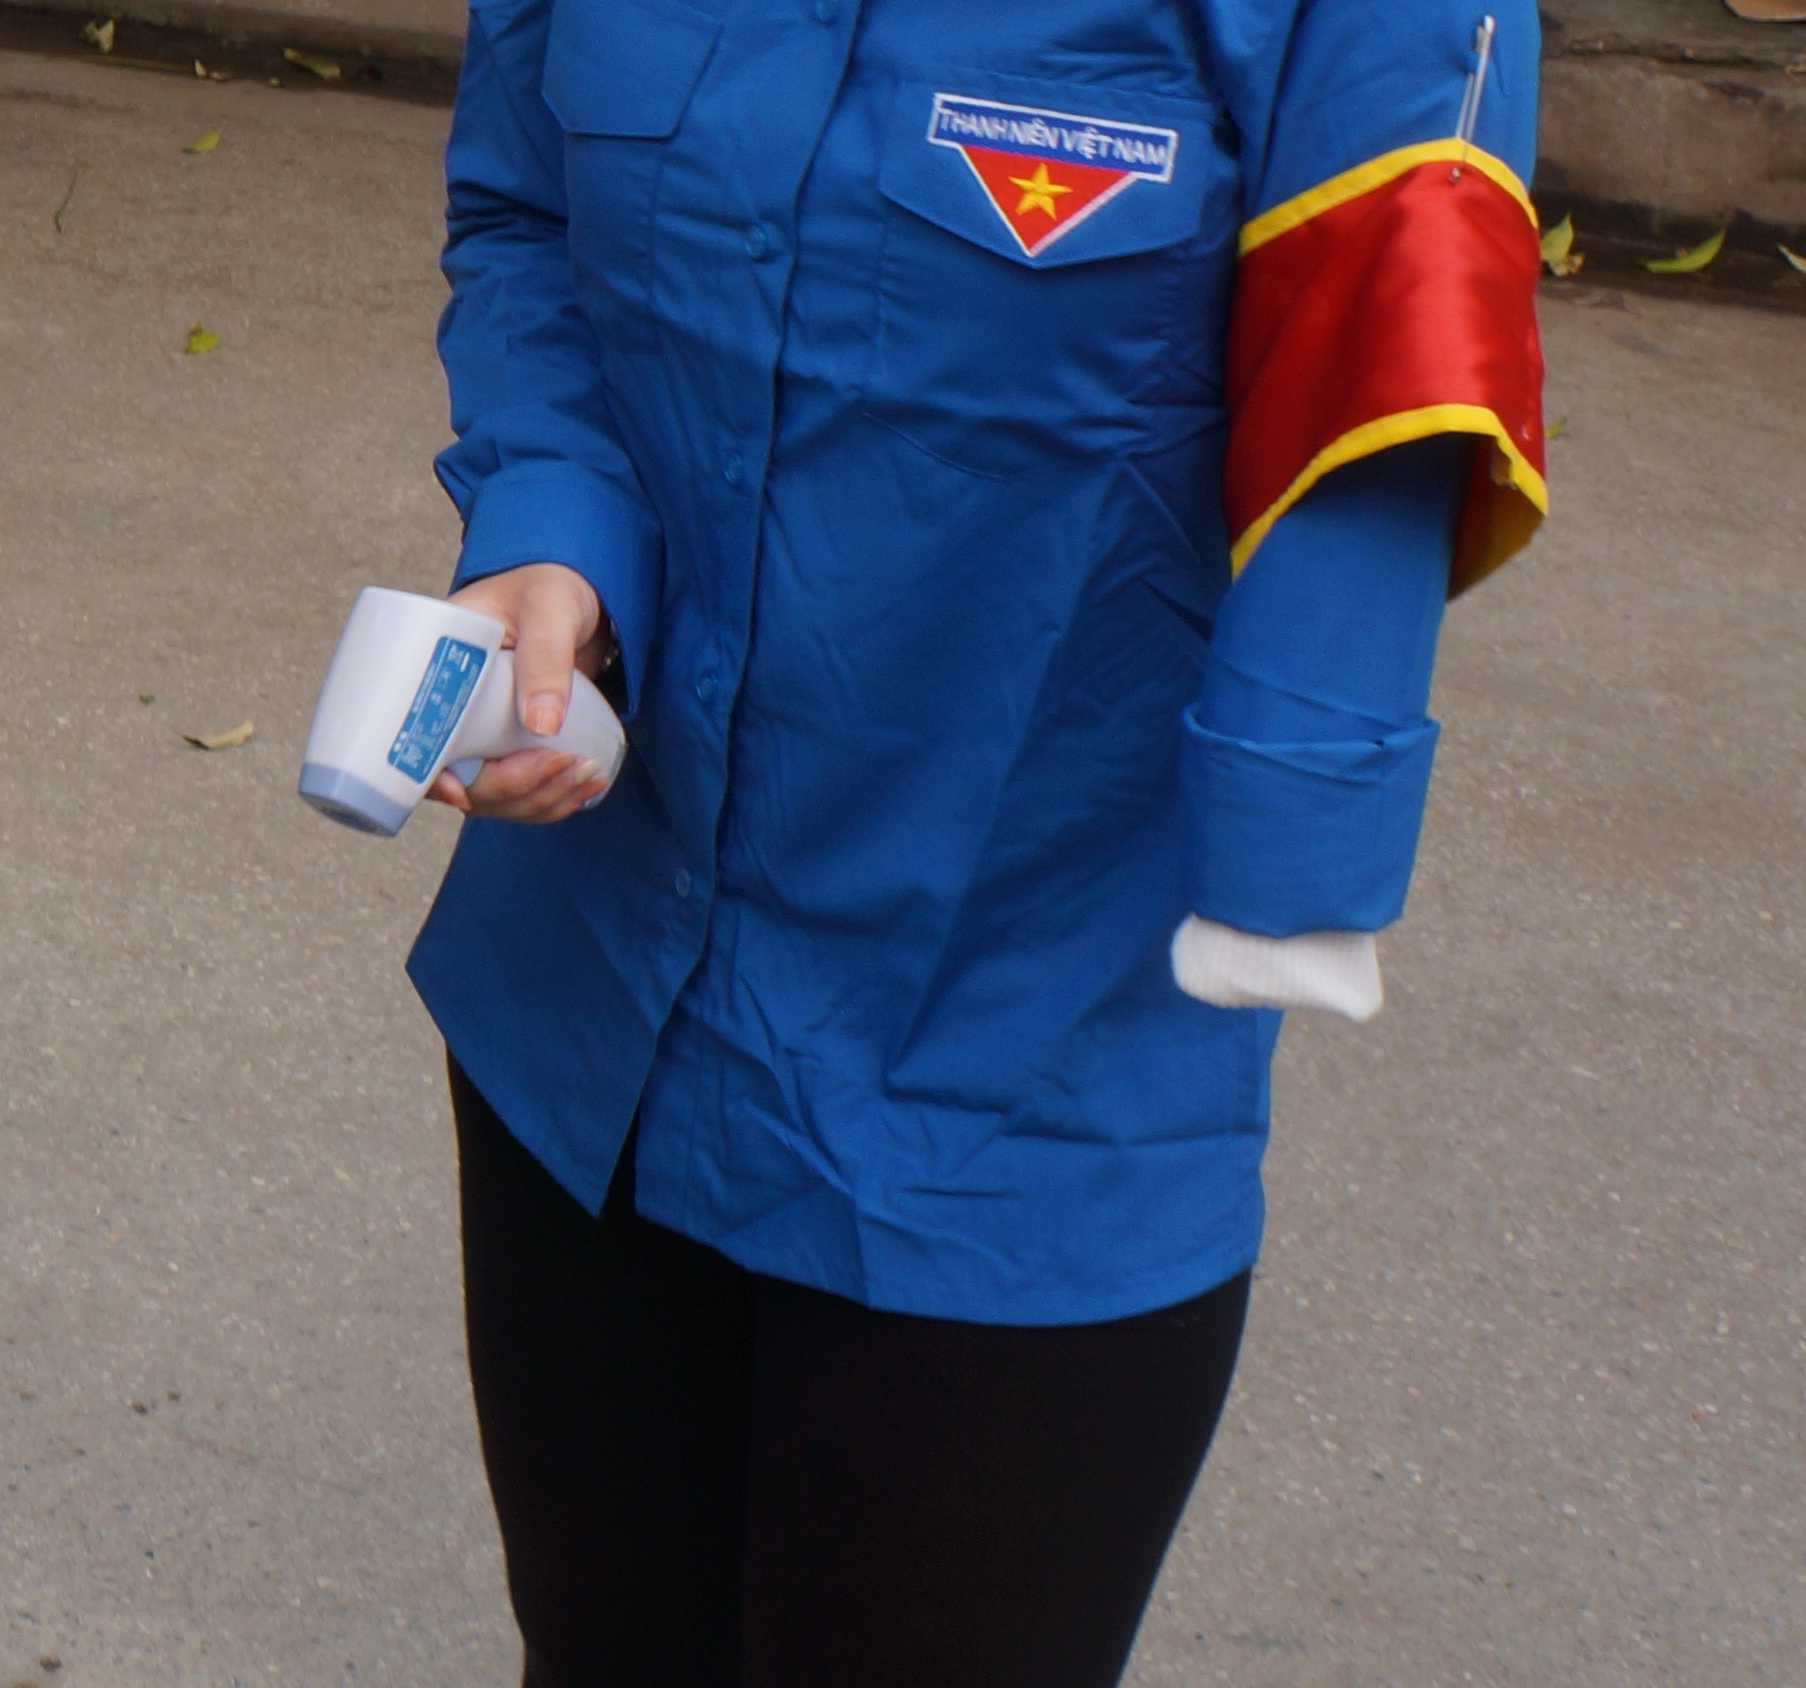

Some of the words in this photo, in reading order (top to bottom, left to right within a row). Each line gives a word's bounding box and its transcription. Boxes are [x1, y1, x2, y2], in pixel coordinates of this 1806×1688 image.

[940, 110, 1008, 141] THANH
[1061, 126, 1113, 160] VIỆT
[1112, 137, 1167, 165] NAM
